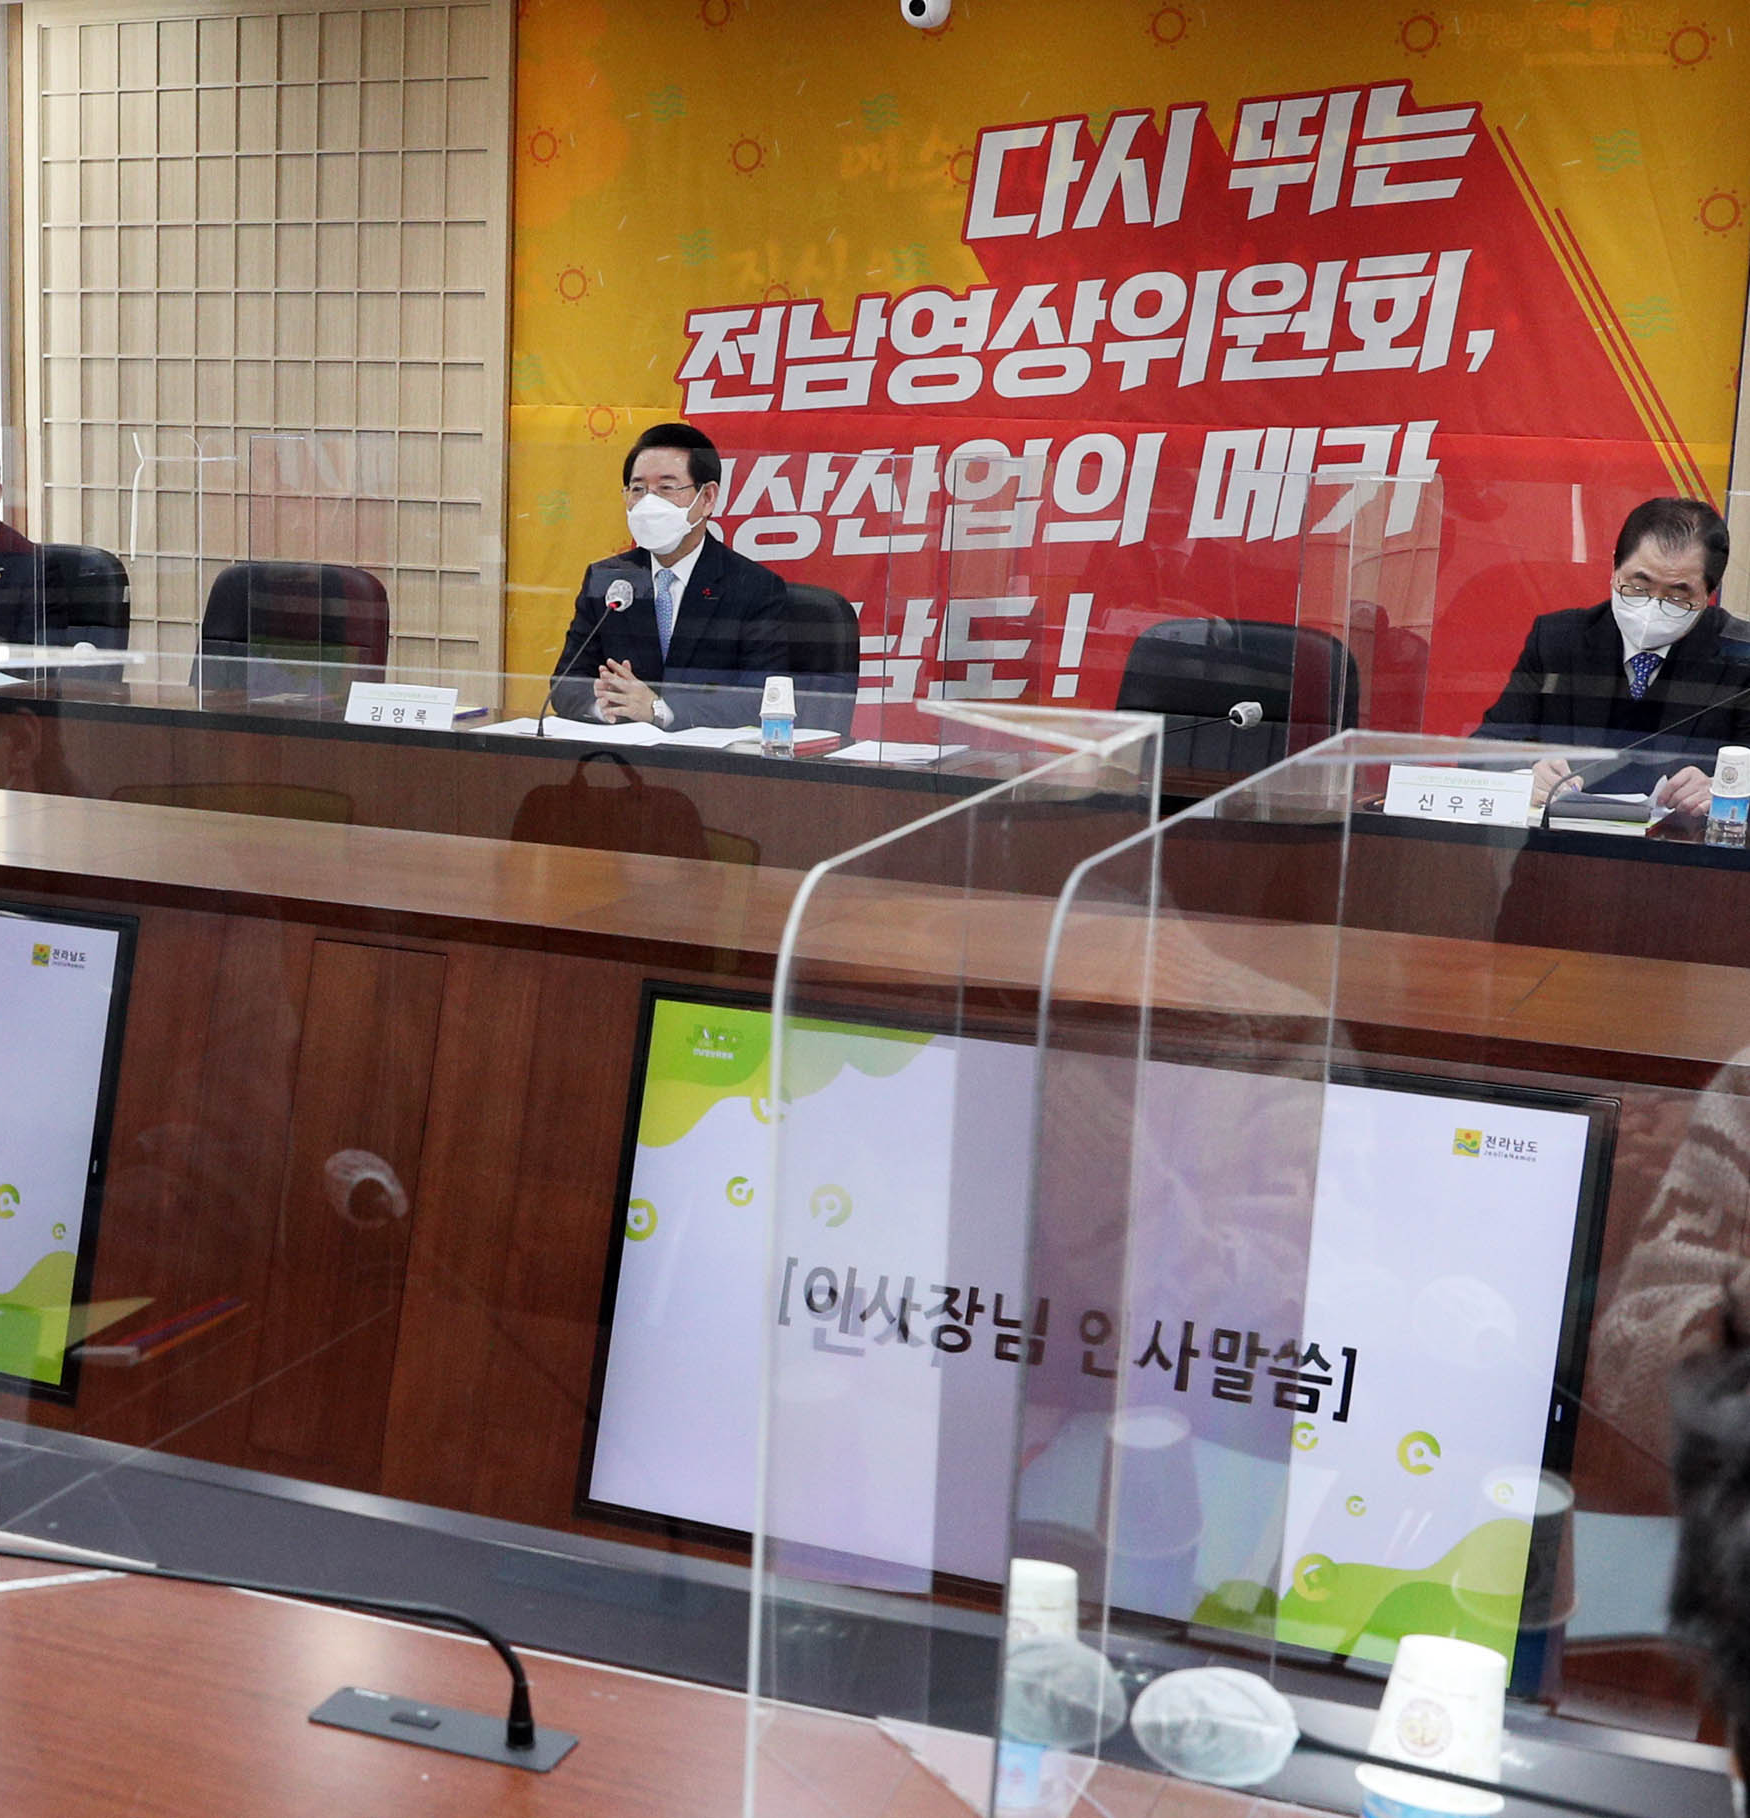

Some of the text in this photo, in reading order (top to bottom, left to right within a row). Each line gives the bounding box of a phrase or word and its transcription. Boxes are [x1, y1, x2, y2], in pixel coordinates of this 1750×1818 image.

[966, 107, 1202, 239] 다시
[1228, 85, 1476, 220] 뛰는
[678, 249, 1495, 415] 전남영상위원회,
[706, 420, 1440, 562] 상산업의 메카
[370, 706, 427, 725] 김영록
[1418, 794, 1495, 816] 신우철
[1484, 1135, 1539, 1153] 전라남도
[1078, 1308, 1359, 1424] 인사말씀]
